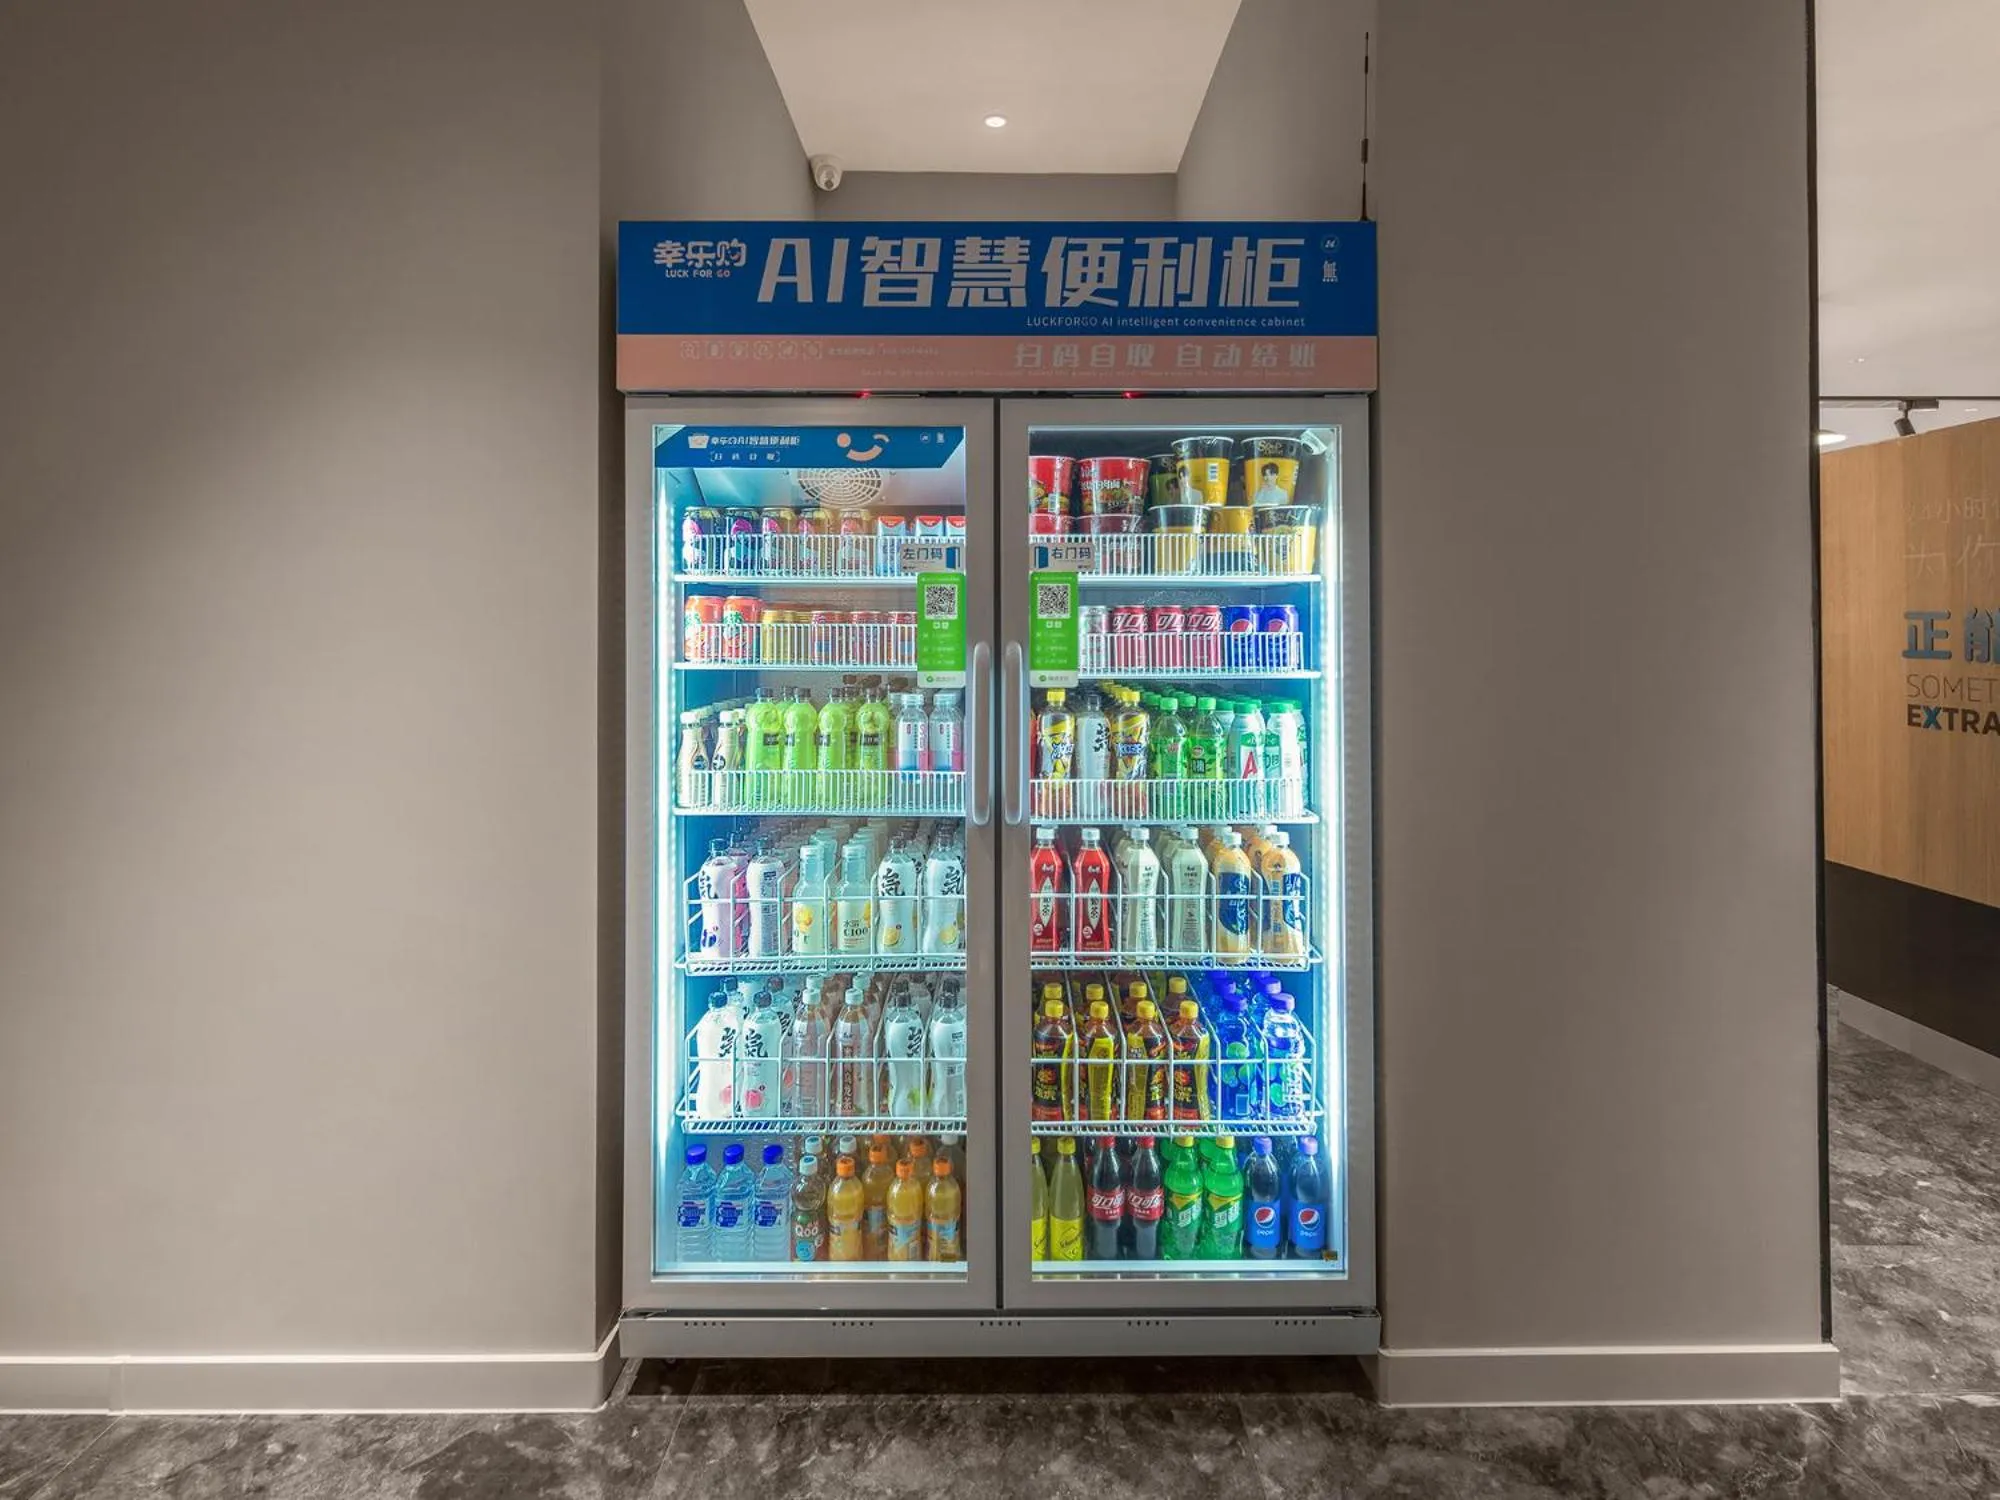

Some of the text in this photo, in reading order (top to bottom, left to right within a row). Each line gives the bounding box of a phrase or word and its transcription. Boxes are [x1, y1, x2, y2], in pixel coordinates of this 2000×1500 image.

[653, 238, 747, 268] 幸乐购
[665, 269, 731, 278] LUCK FOR GO
[757, 236, 1305, 308] AI智慧便利柜
[1026, 316, 1306, 329] LUCKFORGO AI intelligent convenience cabinet
[903, 547, 943, 561] 左门码
[1051, 546, 1091, 560] 右门码
[1906, 674, 1999, 704] SOMET
[1907, 703, 2000, 736] EXTRA
